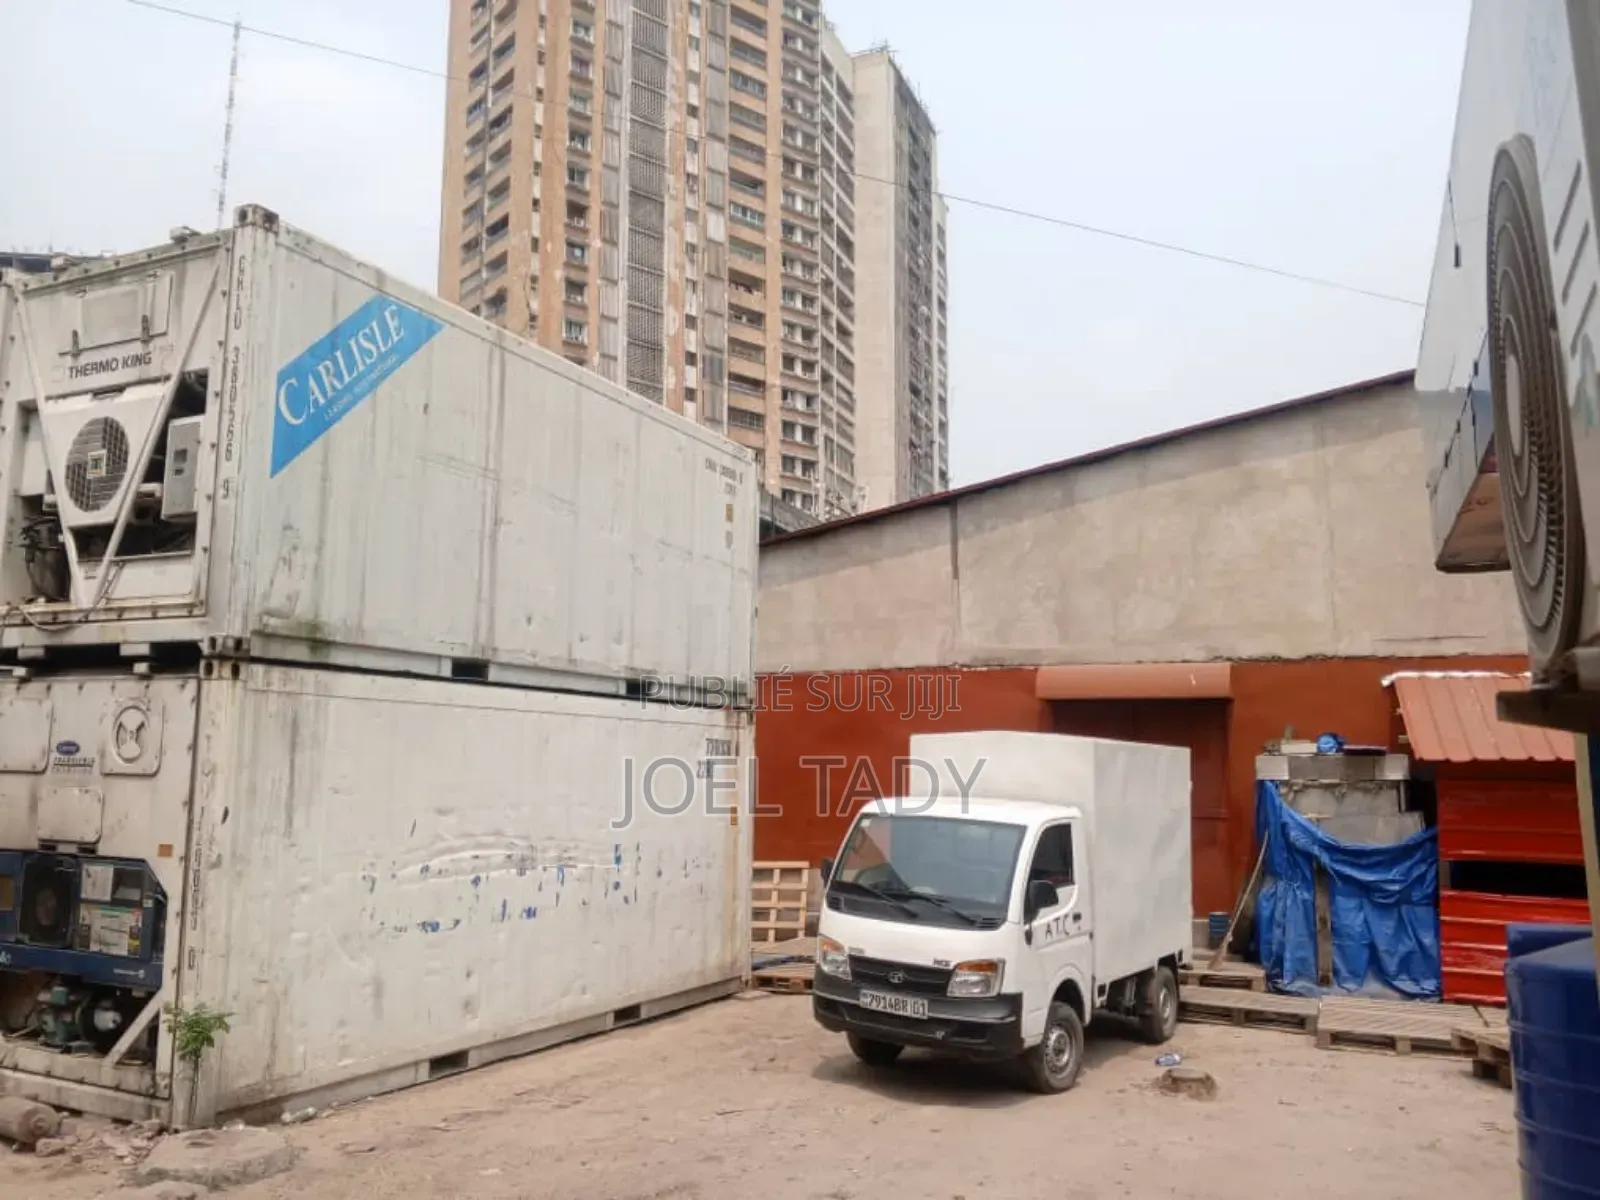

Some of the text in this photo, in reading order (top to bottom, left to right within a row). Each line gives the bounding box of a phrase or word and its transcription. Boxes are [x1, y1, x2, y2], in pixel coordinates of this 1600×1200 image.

[68, 351, 152, 379] THERMO KING
[277, 305, 405, 425] CARLISLE
